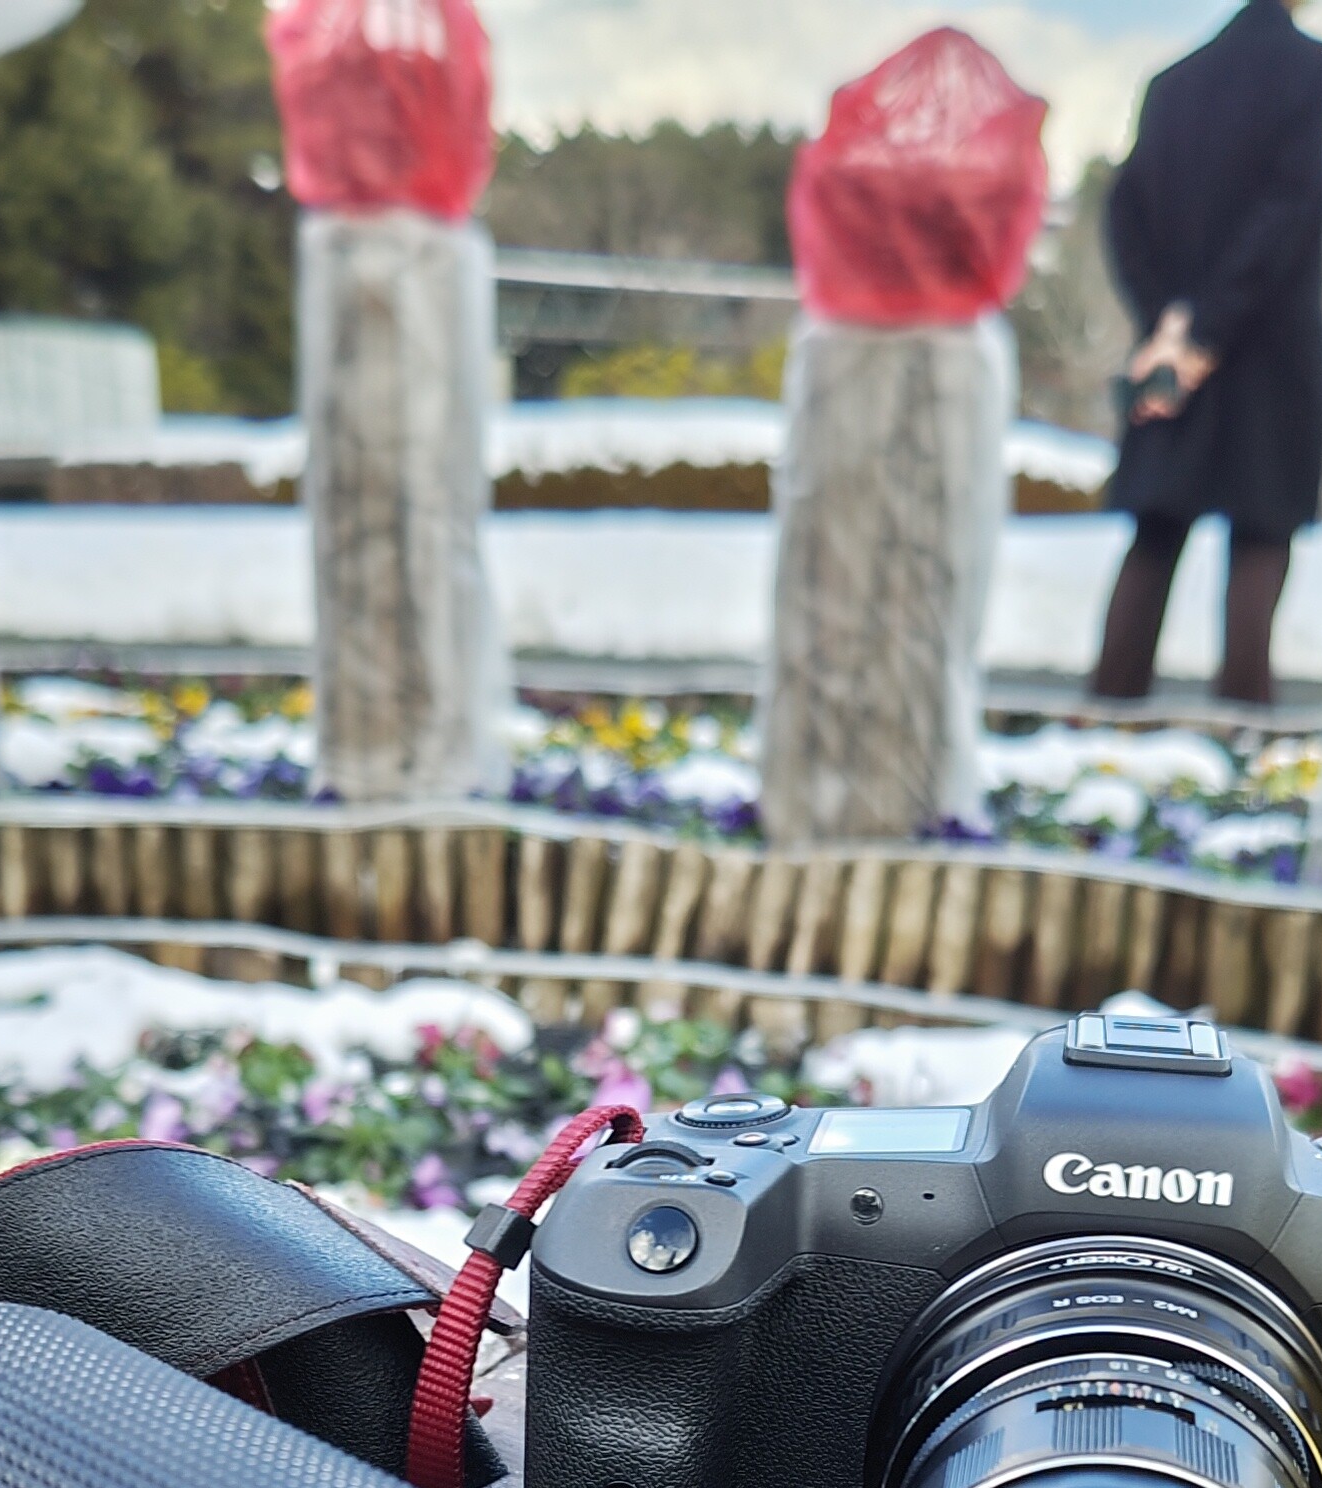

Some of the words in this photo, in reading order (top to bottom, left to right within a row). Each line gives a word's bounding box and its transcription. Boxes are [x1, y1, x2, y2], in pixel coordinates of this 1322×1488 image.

[1042, 1152, 1234, 1207] Canon
[1052, 1297, 1071, 1308] R
[1075, 1294, 1125, 1306] EOS
[1151, 1299, 1199, 1320] M42
